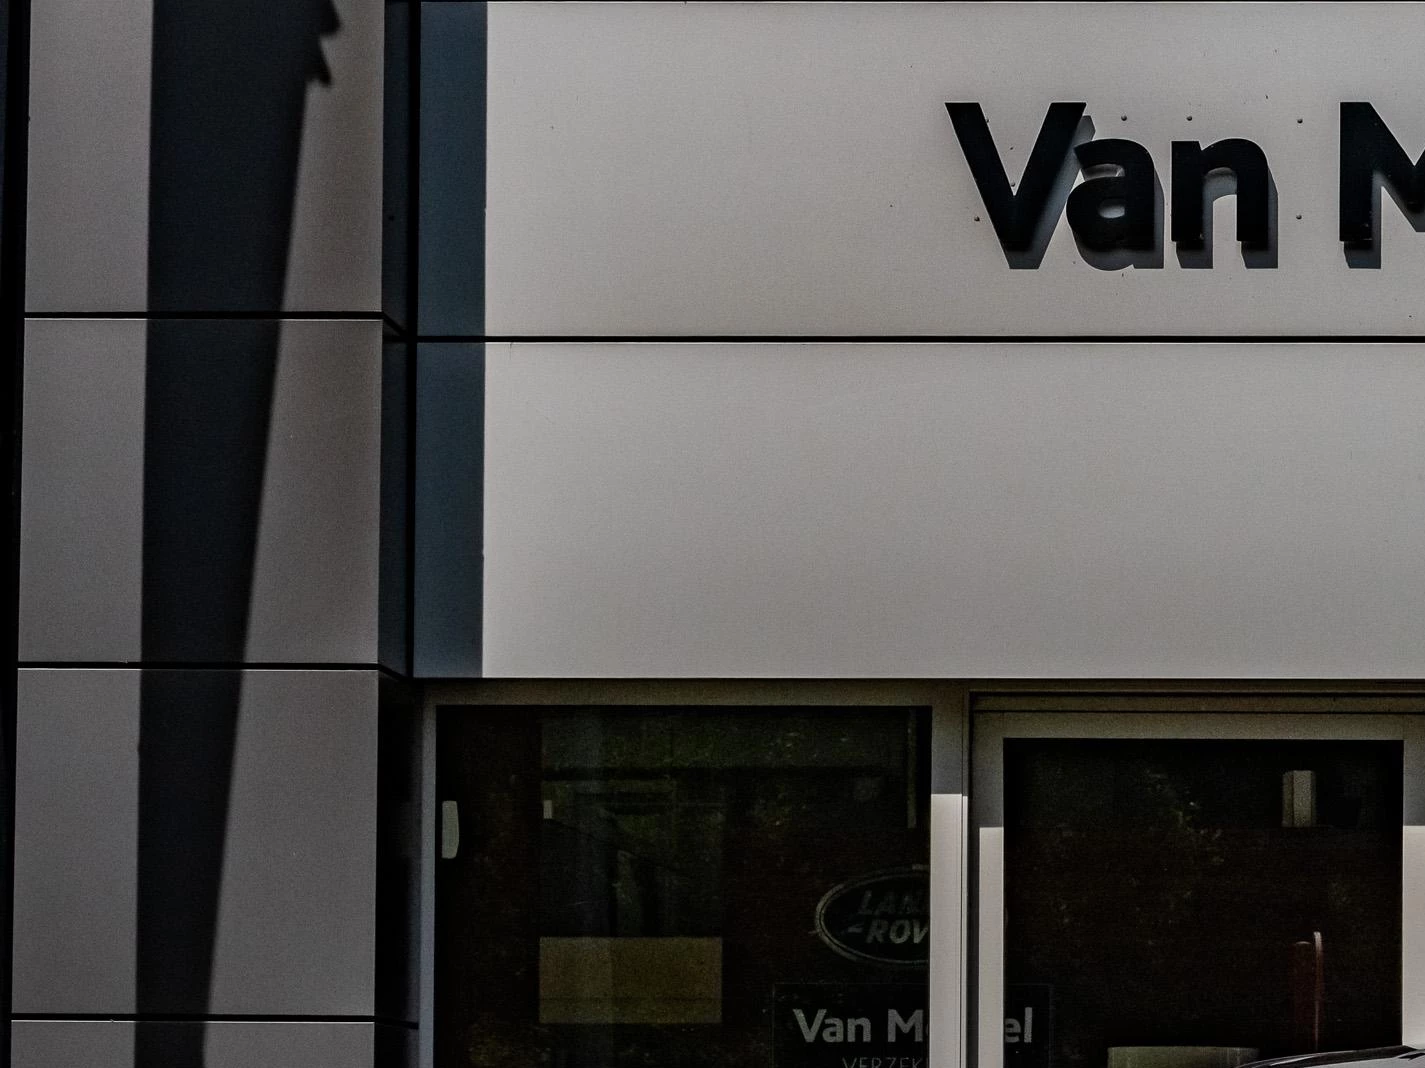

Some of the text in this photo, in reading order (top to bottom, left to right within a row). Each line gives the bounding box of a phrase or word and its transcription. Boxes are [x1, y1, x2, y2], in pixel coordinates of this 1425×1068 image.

[944, 100, 1270, 250] Van
[865, 919, 929, 943] ROV
[792, 1008, 872, 1043] Van
